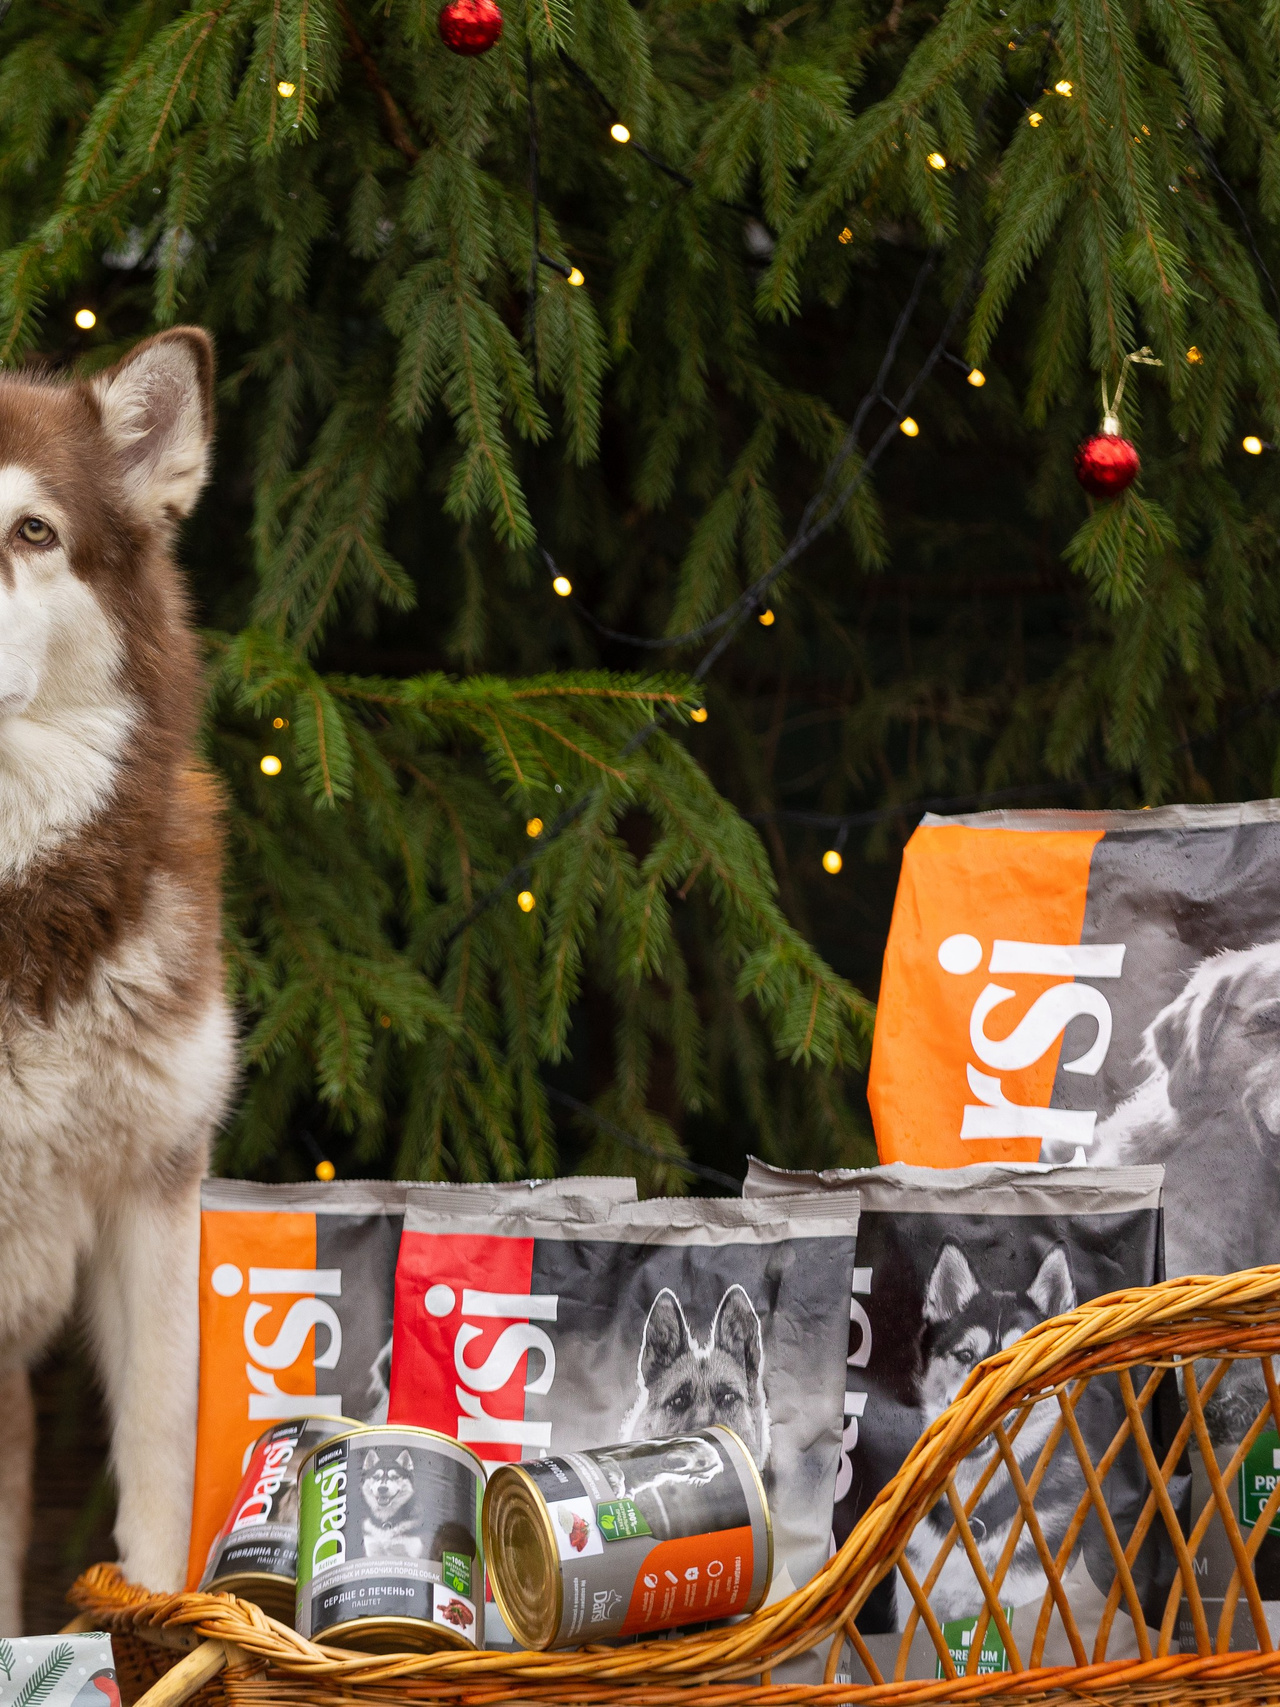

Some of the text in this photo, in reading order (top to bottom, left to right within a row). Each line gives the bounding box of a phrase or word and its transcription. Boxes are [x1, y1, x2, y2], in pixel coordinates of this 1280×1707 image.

[937, 933, 1126, 1166] rsi
[211, 1263, 342, 1420] rsi
[424, 1283, 559, 1456] rsi
[231, 1438, 299, 1533] Darsi
[312, 1461, 348, 1579] Darsi
[227, 1546, 271, 1561] ГОВЯДИНА
[257, 1556, 286, 1566] ПАШТЕТ
[322, 1571, 354, 1588] АКТИВНЫХ
[354, 1569, 360, 1577] И
[361, 1566, 393, 1576] РАБОЧИХ
[394, 1566, 418, 1577] ПОРОД
[419, 1569, 441, 1582] СОБАК
[324, 1586, 415, 1609] СЕРДЦЕ С ПЕЧЕНЬЮ
[351, 1597, 382, 1609] ПАШТЕТ
[591, 1590, 608, 1622] Darsi
[948, 1649, 998, 1663] PREUM
